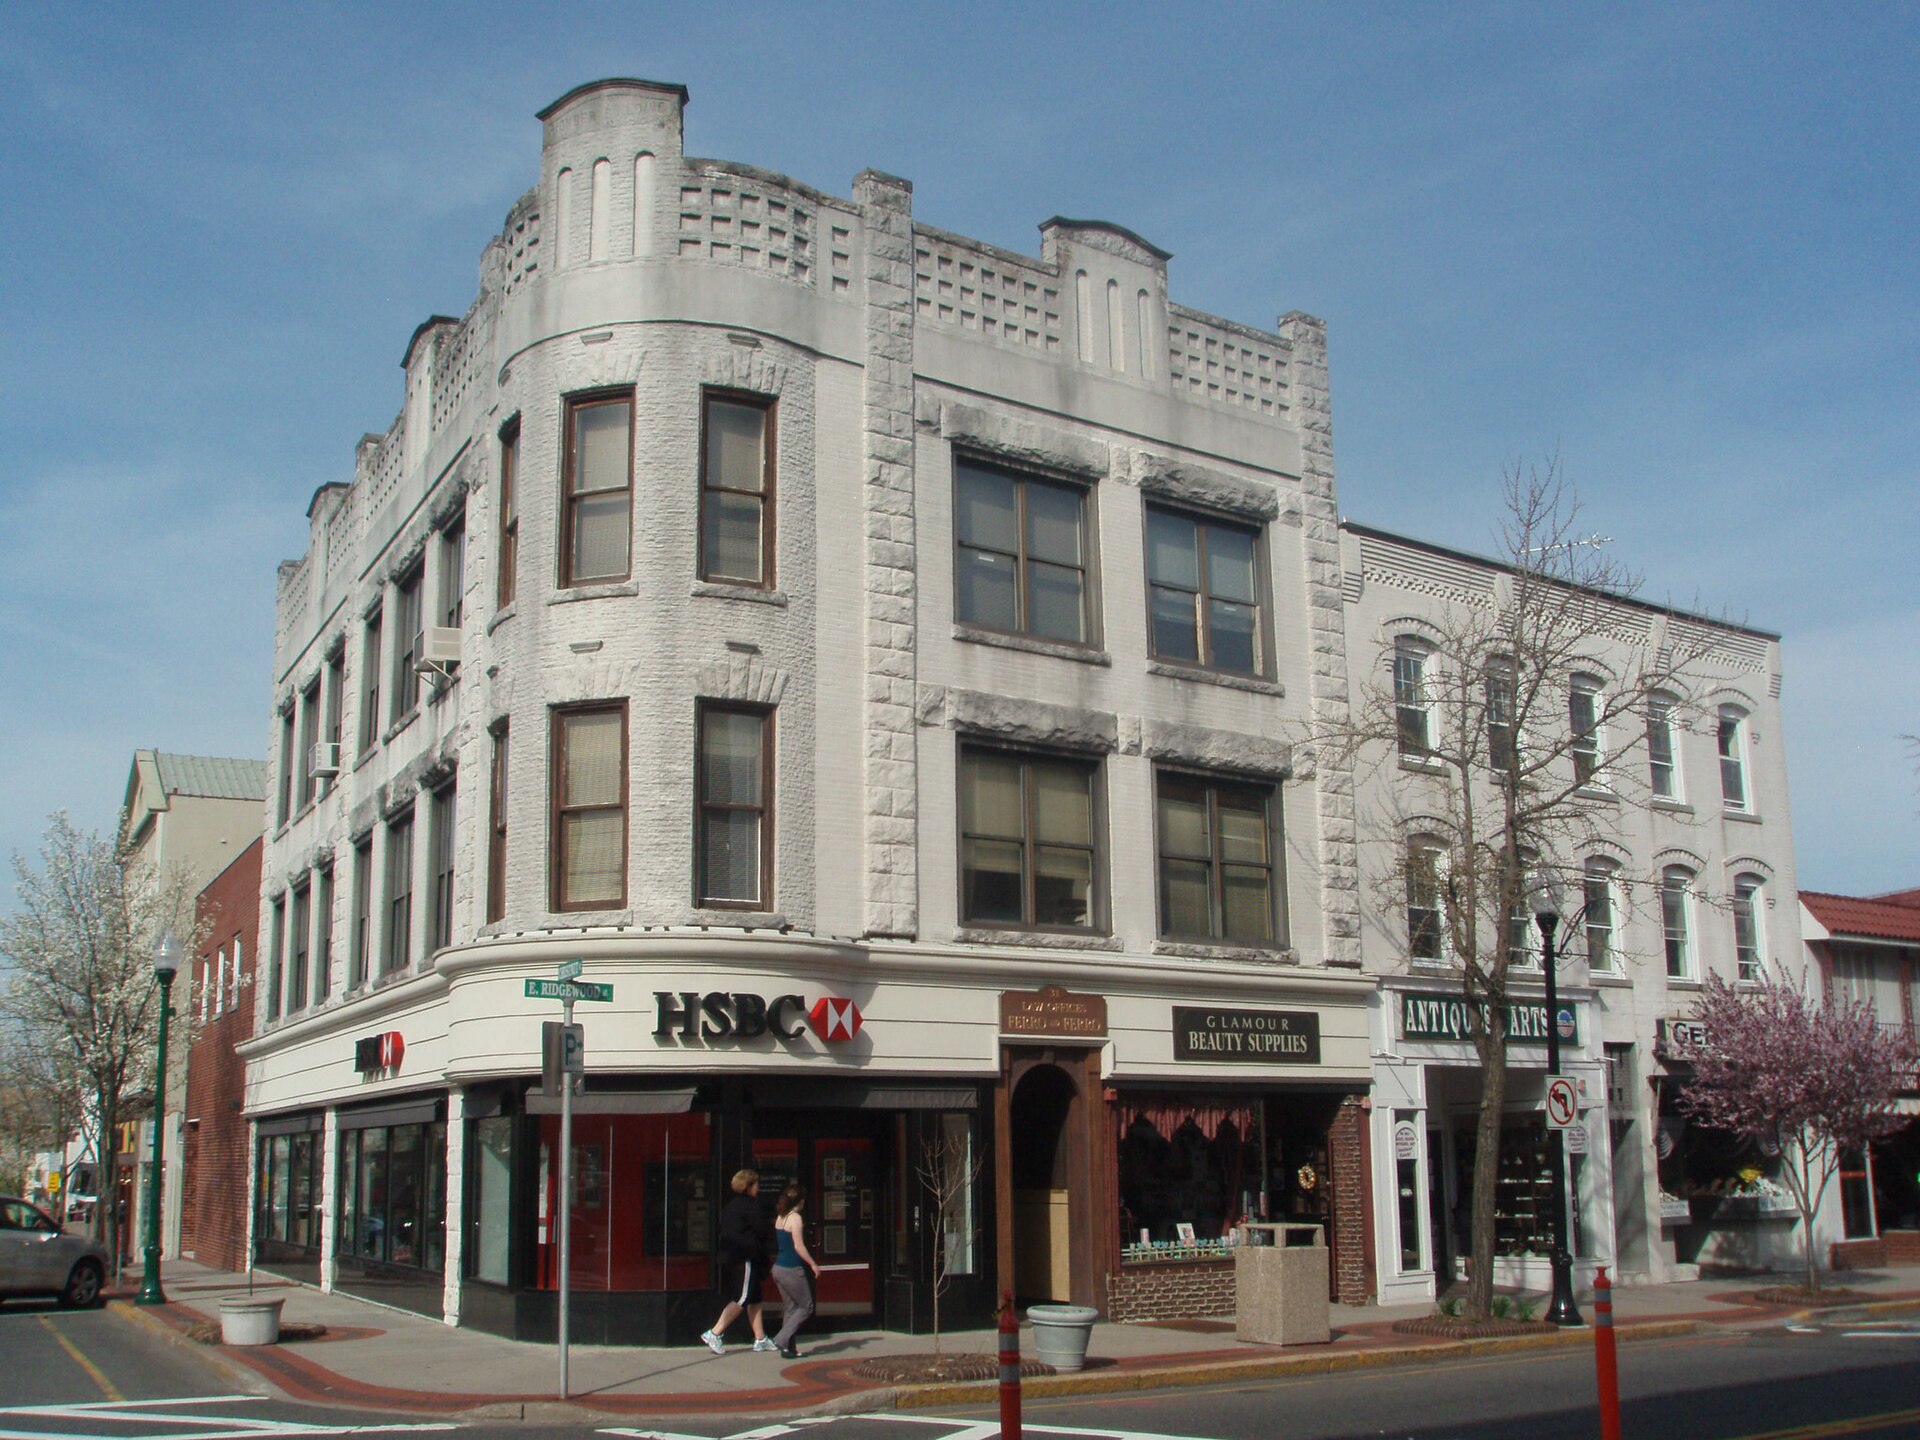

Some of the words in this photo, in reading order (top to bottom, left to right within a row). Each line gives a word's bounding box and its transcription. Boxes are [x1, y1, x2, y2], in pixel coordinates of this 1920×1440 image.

[529, 981, 539, 995] E.
[541, 982, 600, 998] RIDGEWOOD
[651, 992, 806, 1039] HSBC
[1008, 1015, 1047, 1029] FERRO
[1063, 1017, 1101, 1031] FERRO
[1206, 1015, 1289, 1031] GLAMOUR
[1510, 1005, 1548, 1037] ARTS
[565, 1032, 576, 1066] P
[1188, 1031, 1244, 1051] BEAUTY
[1247, 1032, 1308, 1053] SUPPLIES
